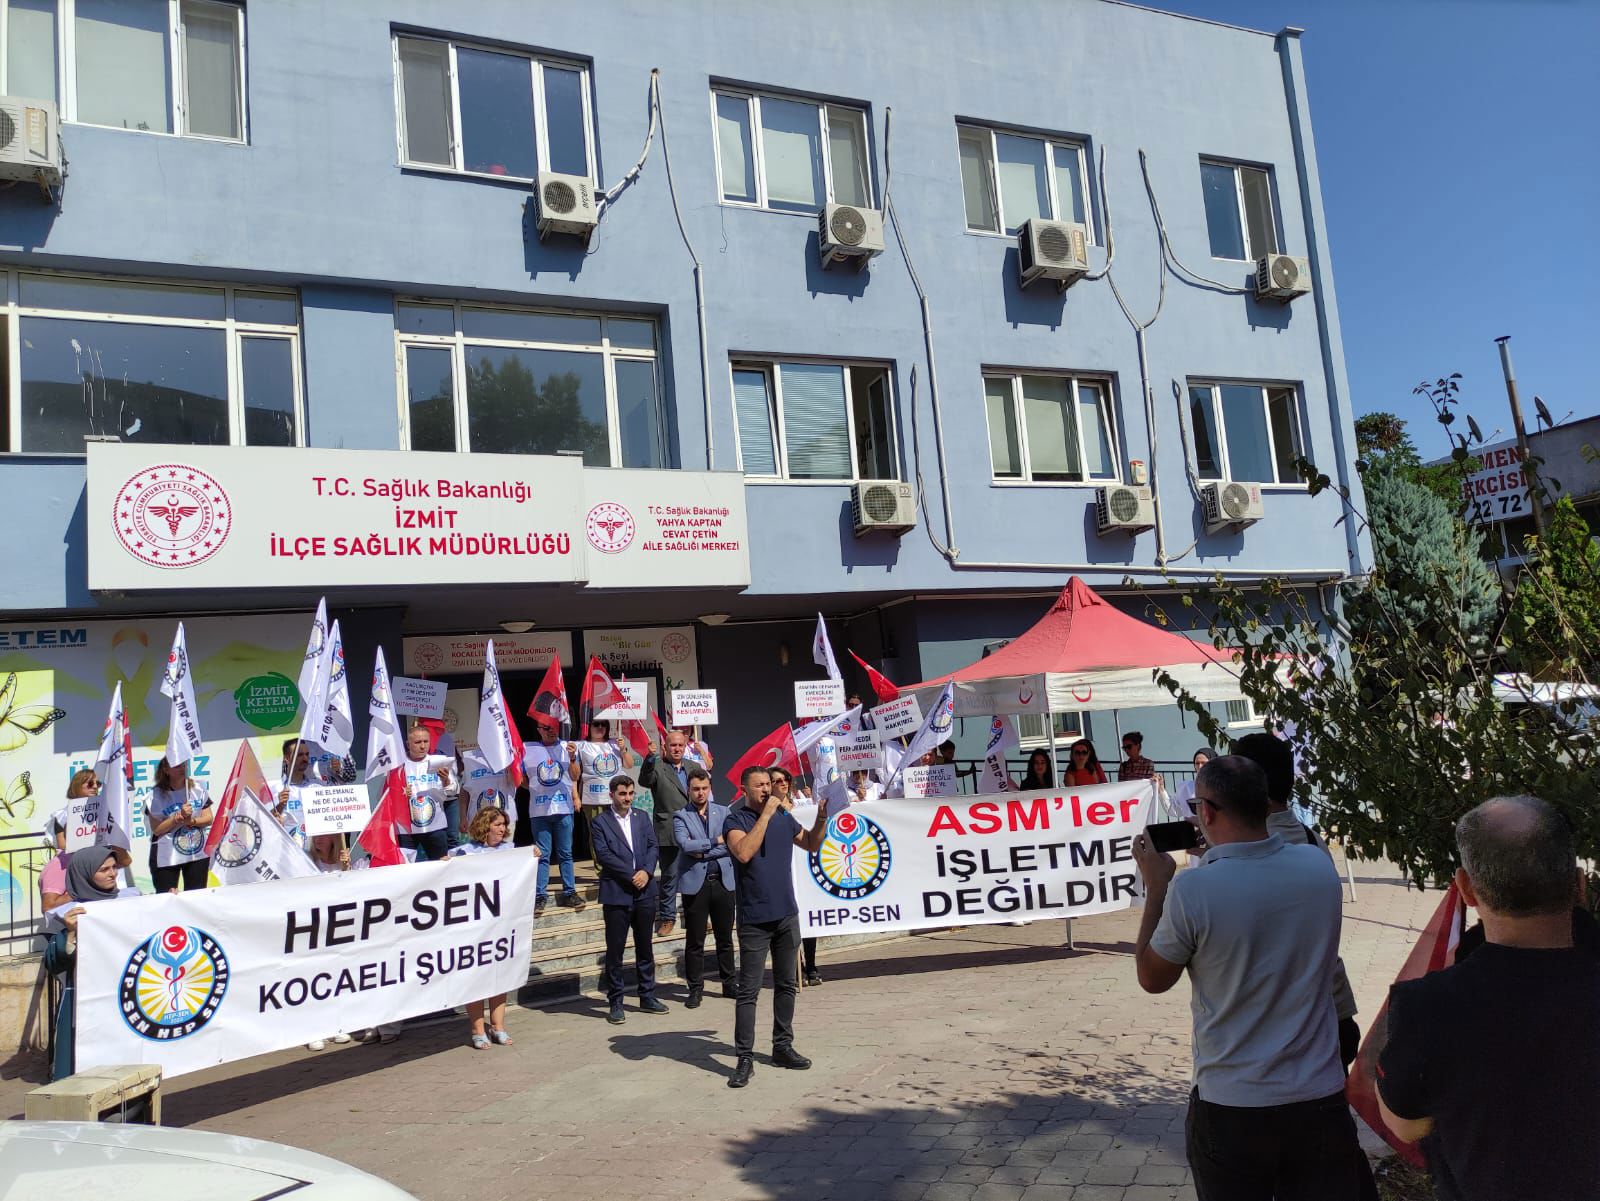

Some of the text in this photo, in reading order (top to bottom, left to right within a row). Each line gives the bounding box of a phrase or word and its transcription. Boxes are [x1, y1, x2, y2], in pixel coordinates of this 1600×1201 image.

[1479, 446, 1521, 470] MEN
[312, 477, 531, 503] T.C. Sağlık Bakanlığı
[395, 505, 458, 529] İZMİT
[648, 506, 729, 517] T.C. Sağlık Bakanlığı
[656, 519, 722, 527] YAHYA KAPTAN
[270, 532, 570, 560] İLÇE SAĞLIK MÜDÜRLÜĞÜ
[642, 541, 740, 551] AİLE SAĞLIĞI MERKEZİ
[662, 528, 718, 539] CEVAT ÇETİN
[247, 695, 294, 707] KETEM
[251, 684, 289, 697] İZMİT
[927, 795, 1139, 838] ASM'ler
[838, 887, 867, 898] HEP
[869, 825, 890, 888] SENİNLE
[936, 836, 1133, 883] İŞLETME
[284, 879, 501, 954] HEP-SEN
[809, 904, 900, 927] HEP-SEN
[415, 929, 517, 986] ŞUBESİ
[123, 939, 227, 1038] HEP-SEN HEP SENİNLE
[259, 950, 406, 1013] KOCAELİ
